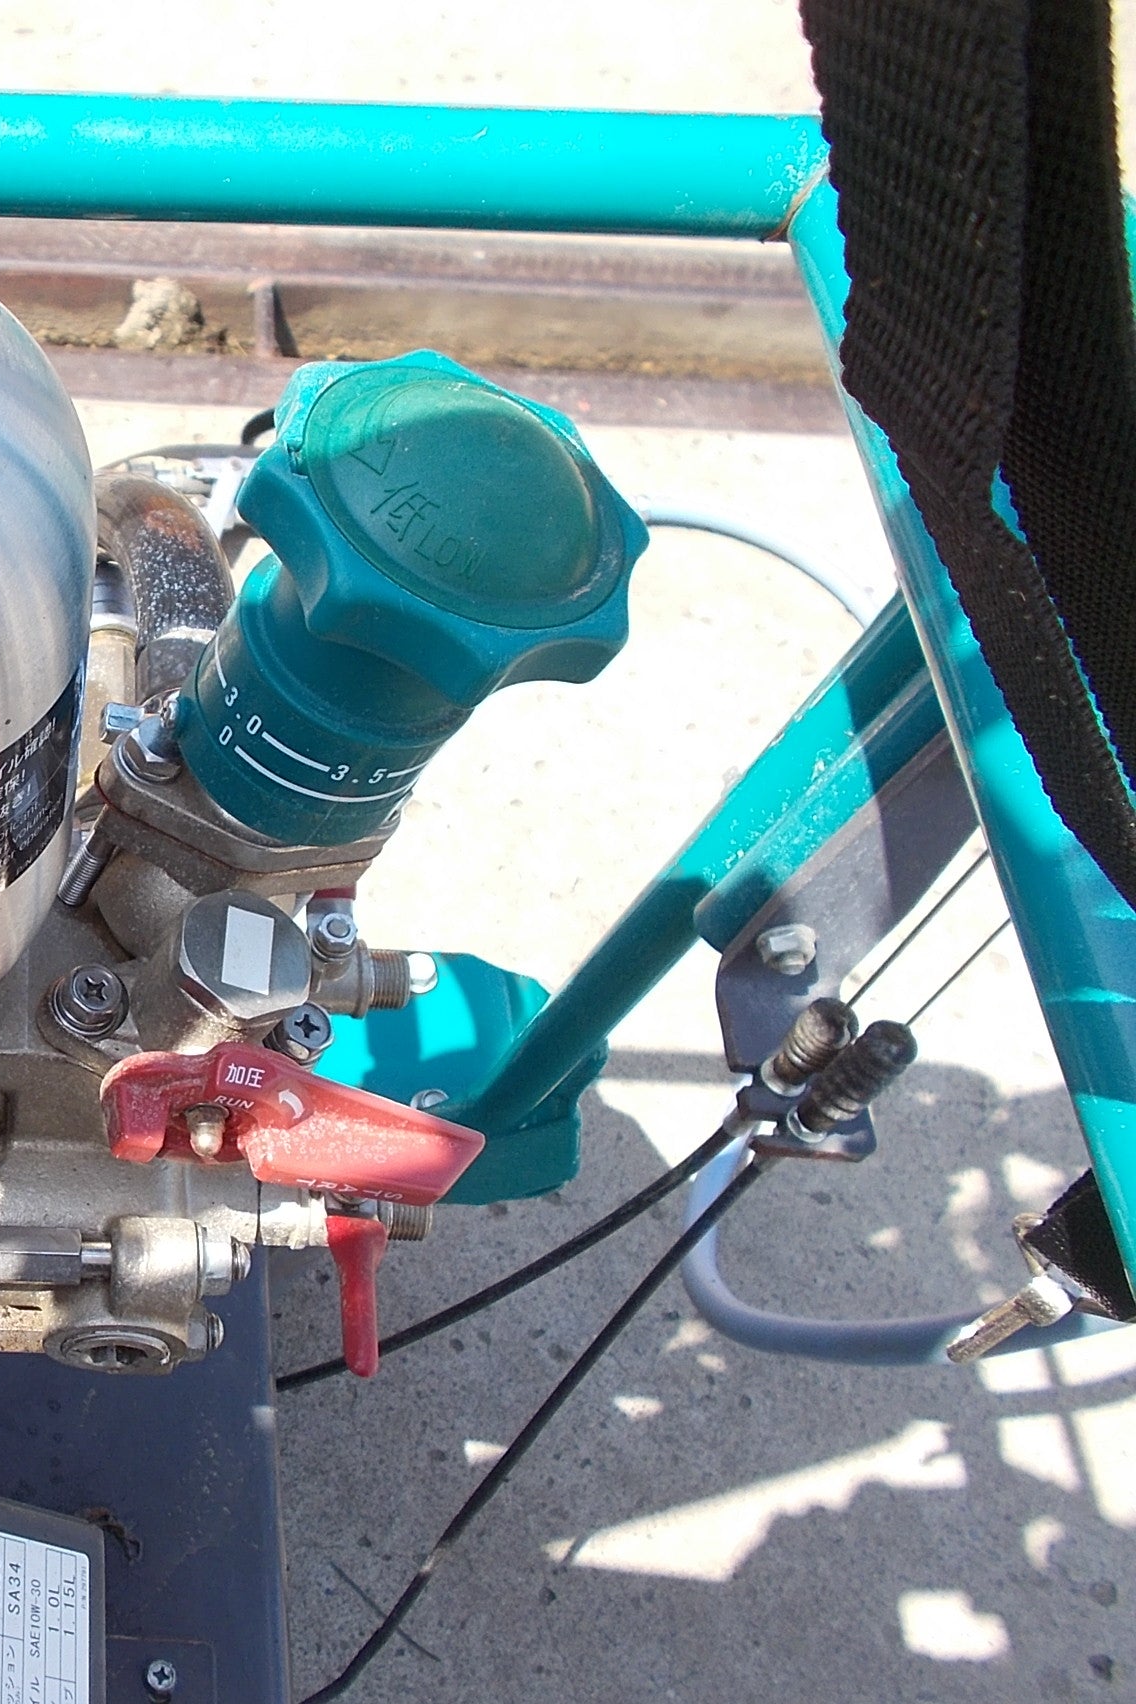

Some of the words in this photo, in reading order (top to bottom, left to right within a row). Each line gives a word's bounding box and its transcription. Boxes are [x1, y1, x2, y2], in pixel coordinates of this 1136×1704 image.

[224, 686, 262, 735] 3.0
[218, 725, 233, 746] 0
[331, 764, 387, 785] 3.5
[225, 1063, 265, 1089] 加圧
[214, 1094, 255, 1110] RUN
[296, 1178, 404, 1201] START
[8, 1562, 21, 1615] SA34
[30, 1579, 41, 1658] SAE10W-30
